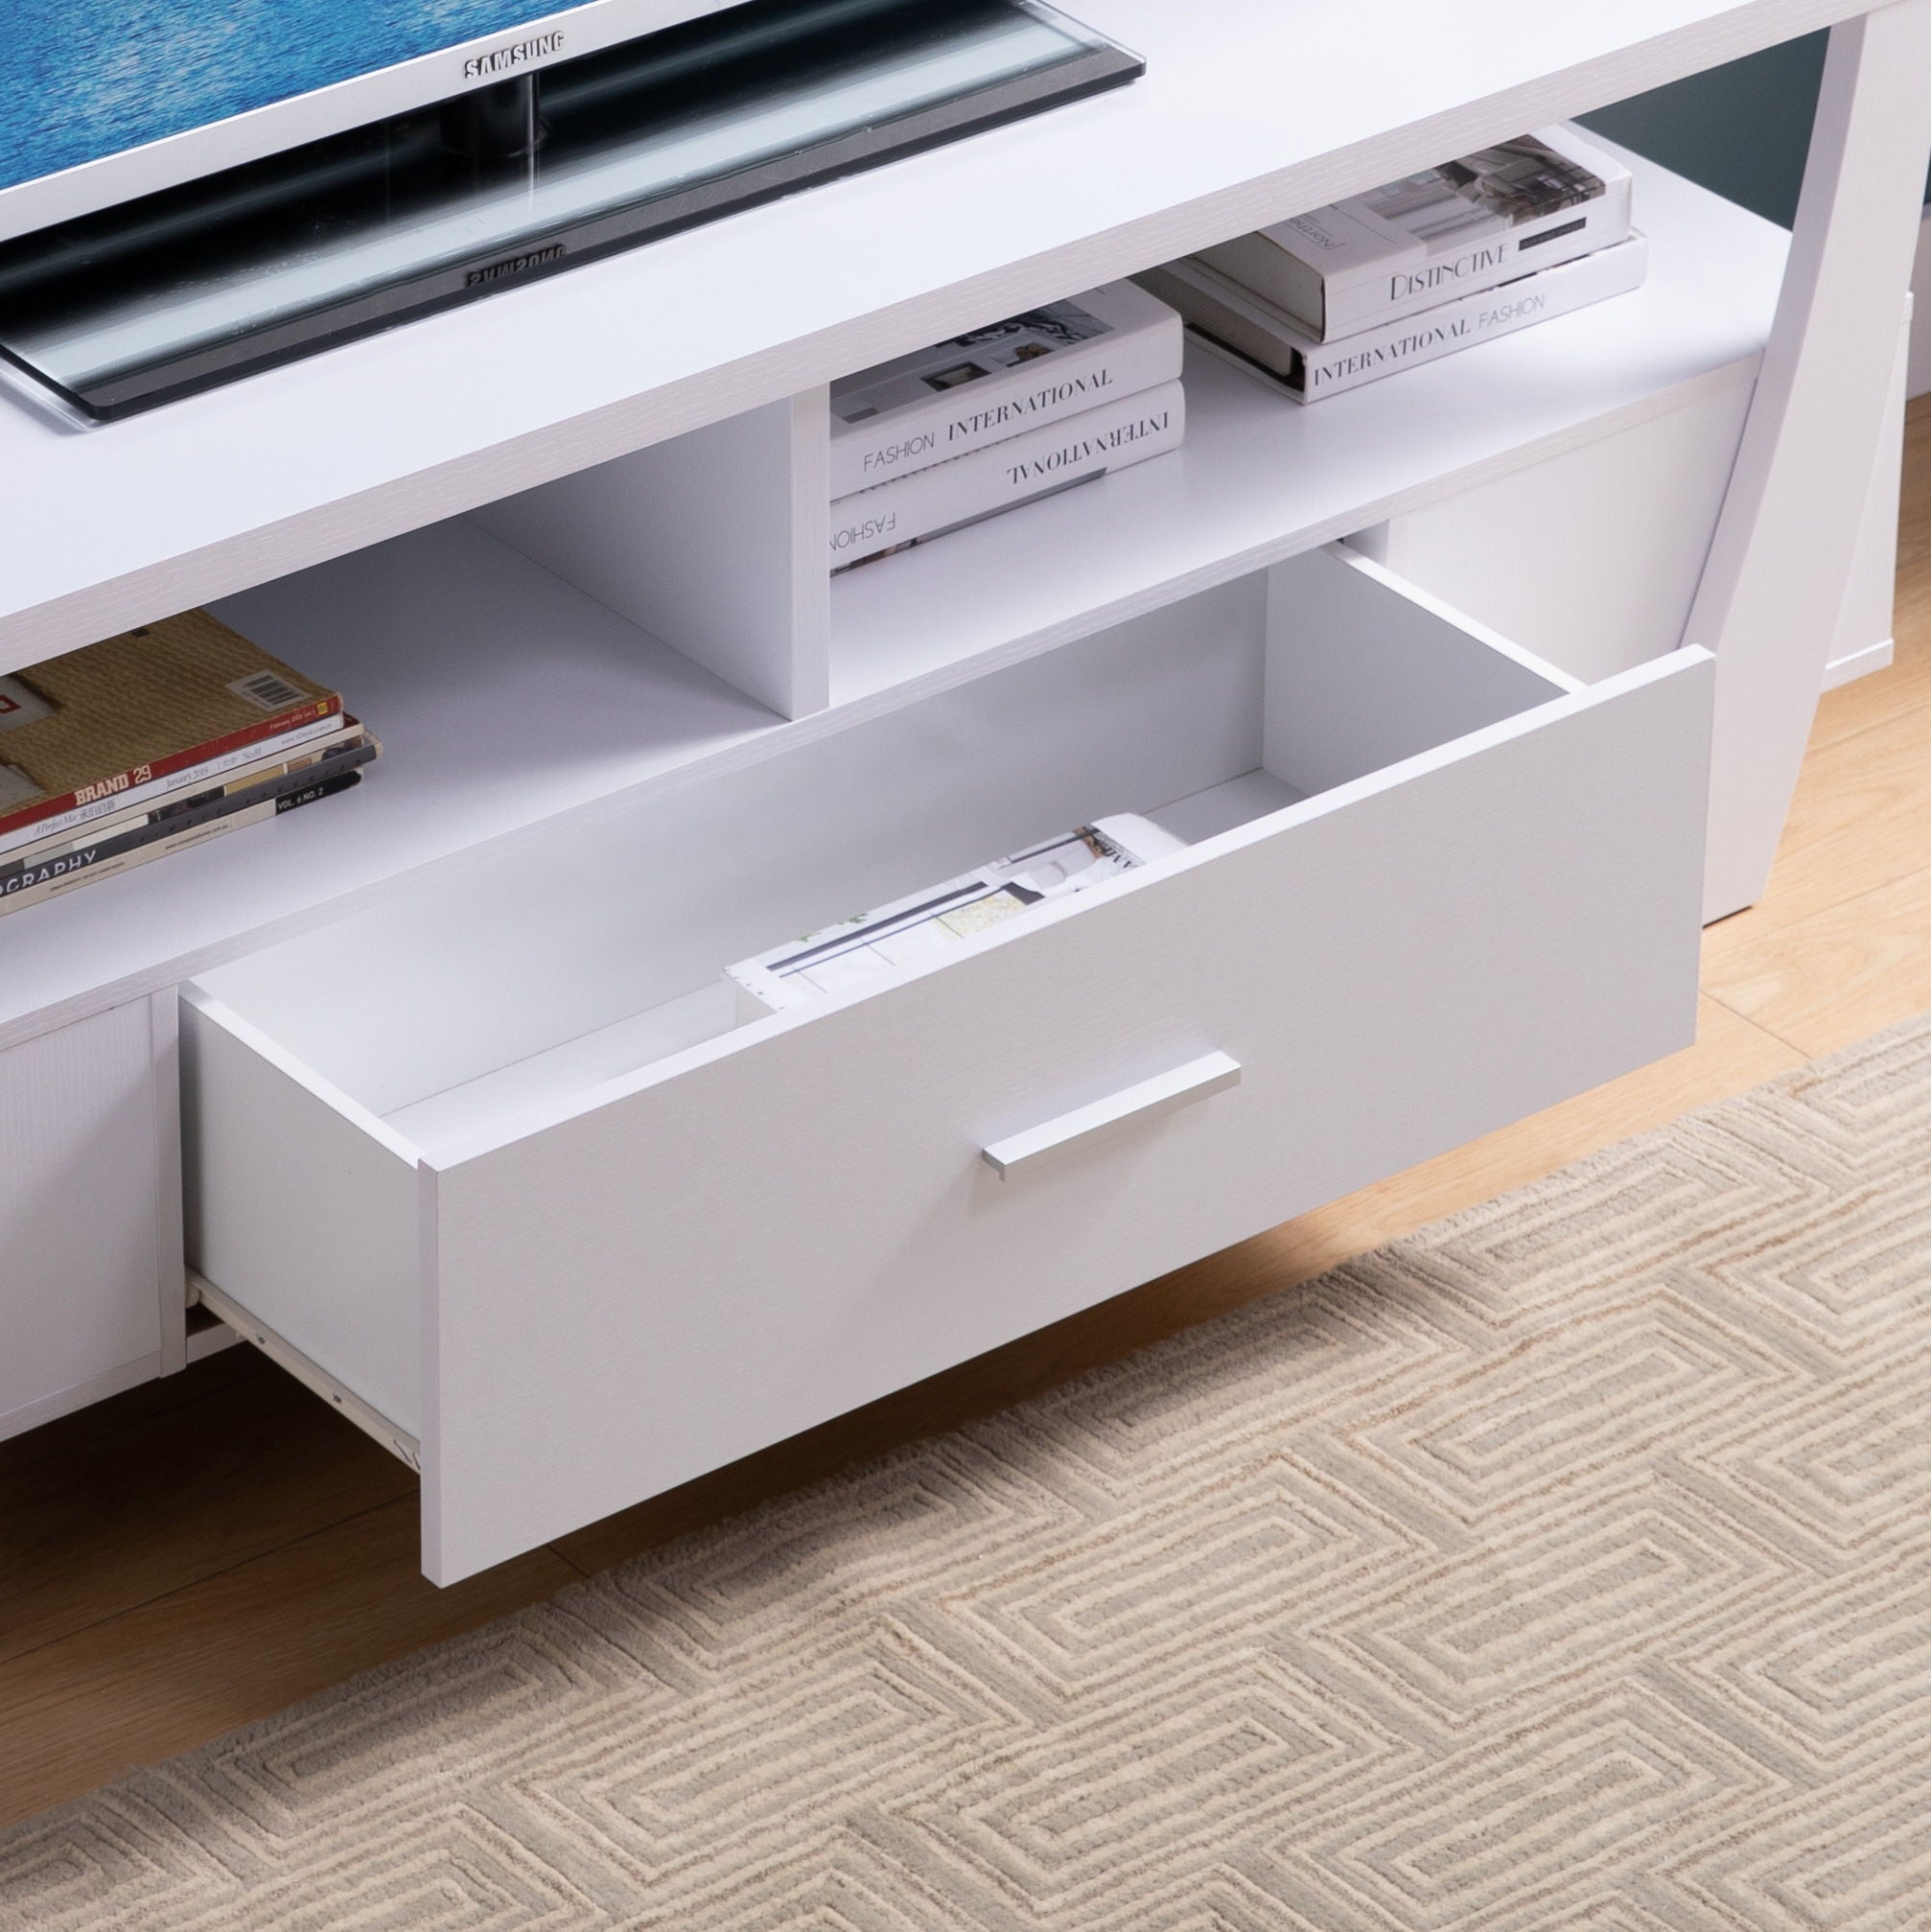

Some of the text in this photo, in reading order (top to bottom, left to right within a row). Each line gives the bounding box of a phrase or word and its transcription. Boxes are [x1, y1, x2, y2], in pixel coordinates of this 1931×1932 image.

[464, 31, 565, 79] SAMSUNG
[1314, 294, 1546, 386] INTERNATIONAL FASHION
[863, 368, 1112, 472] FASHION INTERNATIONAL
[1007, 410, 1169, 484] INTERNATIONAL
[75, 764, 152, 806] BRAND 29
[0, 850, 96, 896] GRAPHY
